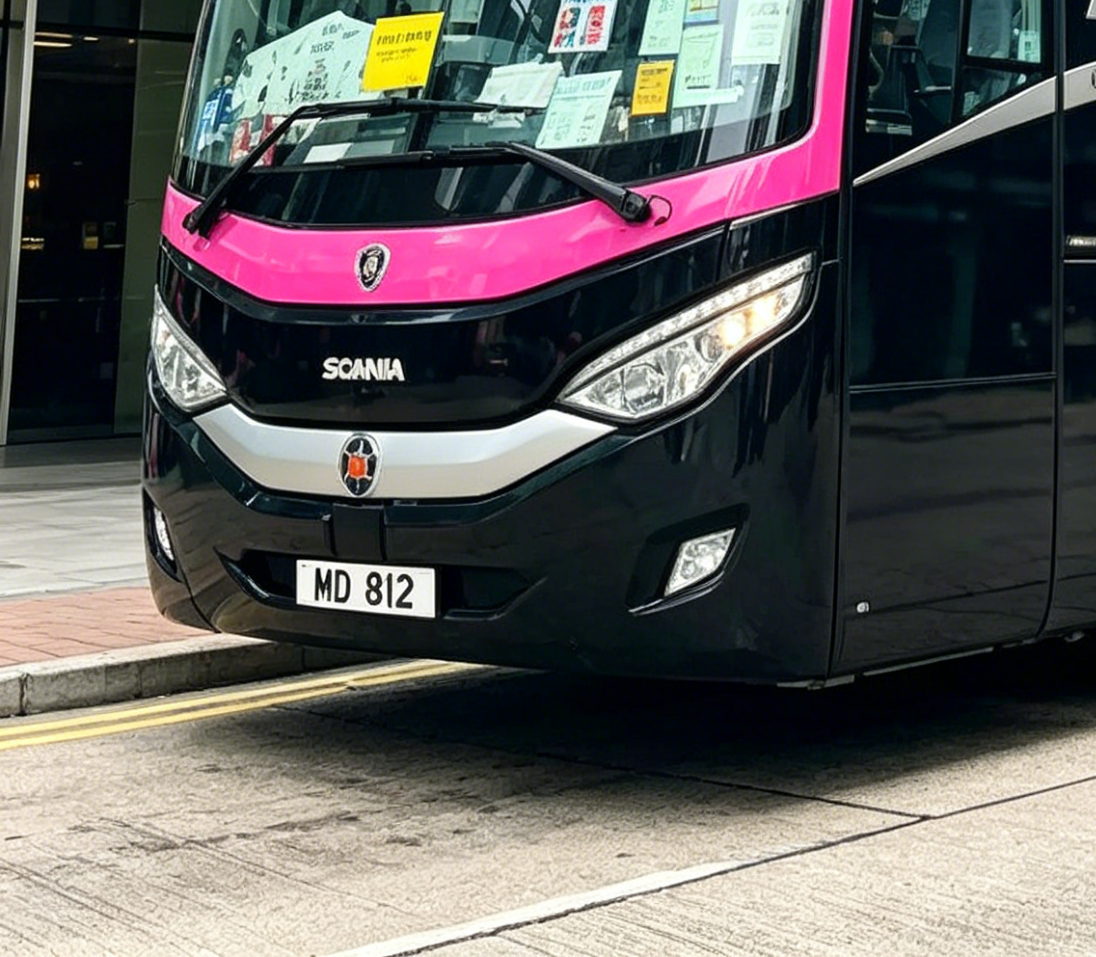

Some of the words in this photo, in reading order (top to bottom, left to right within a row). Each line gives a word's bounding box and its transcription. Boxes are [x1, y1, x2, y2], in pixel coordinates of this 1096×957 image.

[322, 357, 405, 381] SCANIA
[315, 567, 351, 604] MD
[365, 571, 414, 609] 812
